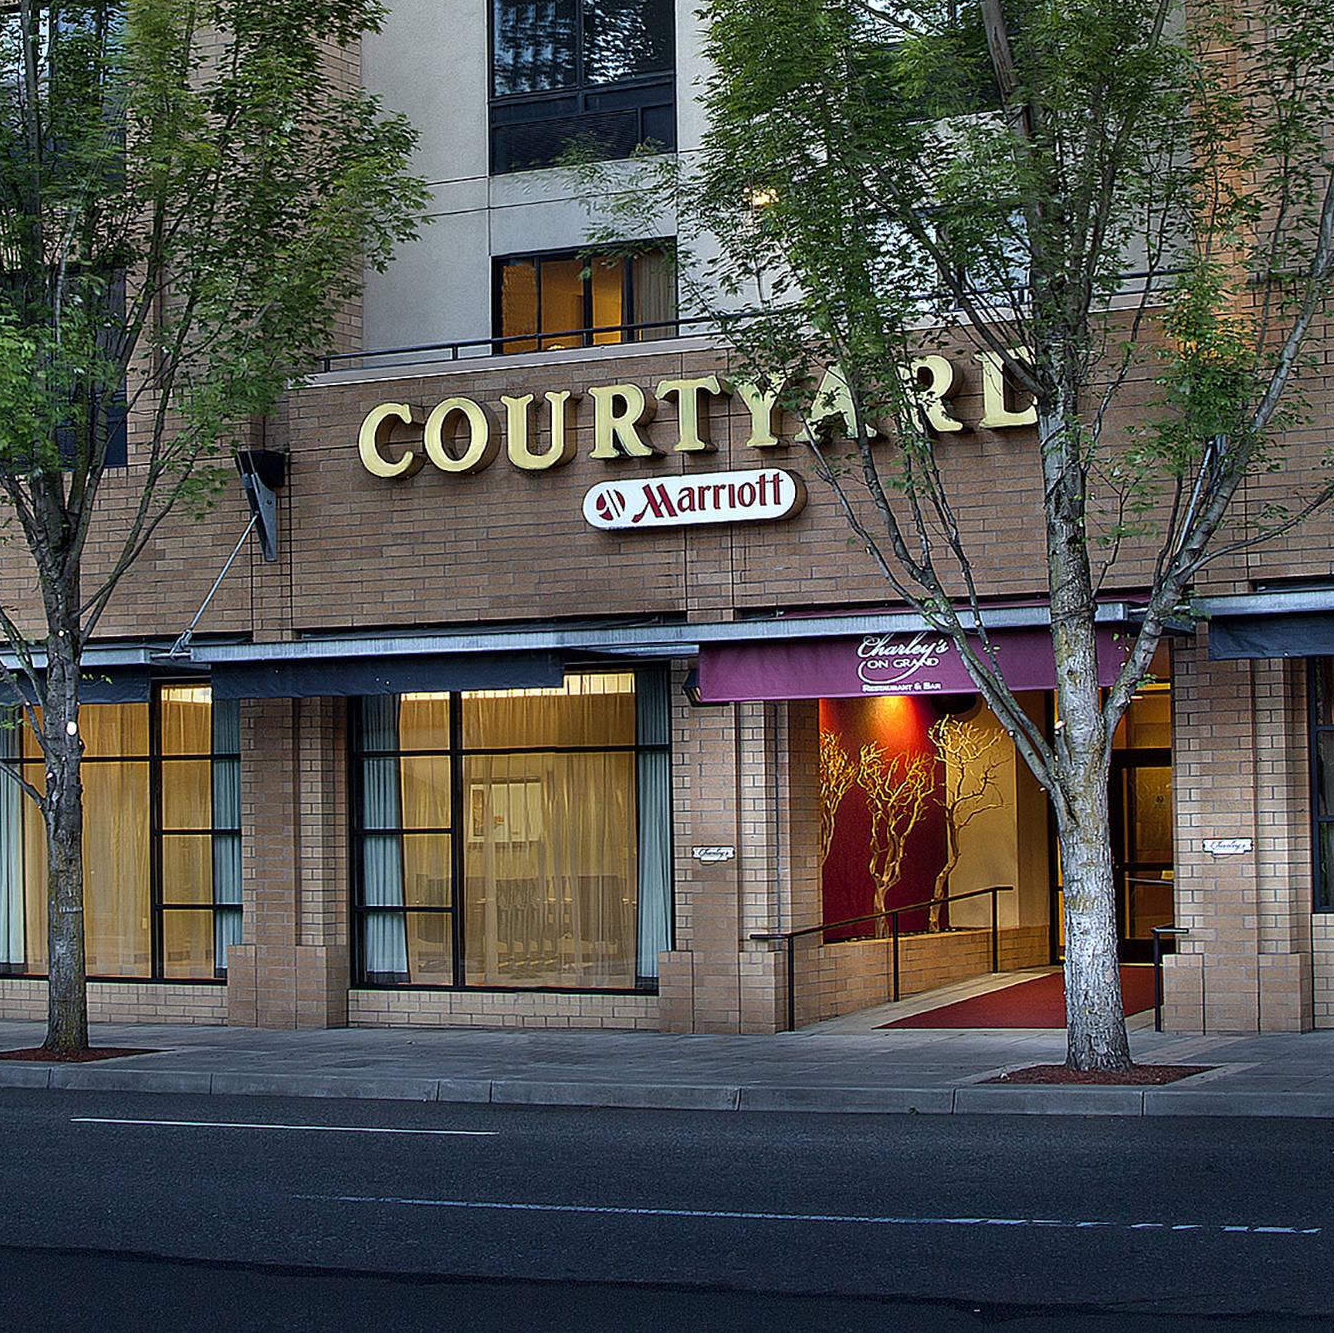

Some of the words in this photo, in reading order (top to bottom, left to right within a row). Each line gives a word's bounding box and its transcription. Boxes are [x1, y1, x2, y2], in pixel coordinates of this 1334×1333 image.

[358, 346, 1038, 478] COURTYARD
[632, 472, 785, 523] Marriott
[857, 631, 949, 684] Charley's
[867, 659, 888, 669] ON
[892, 657, 939, 668] GRAND
